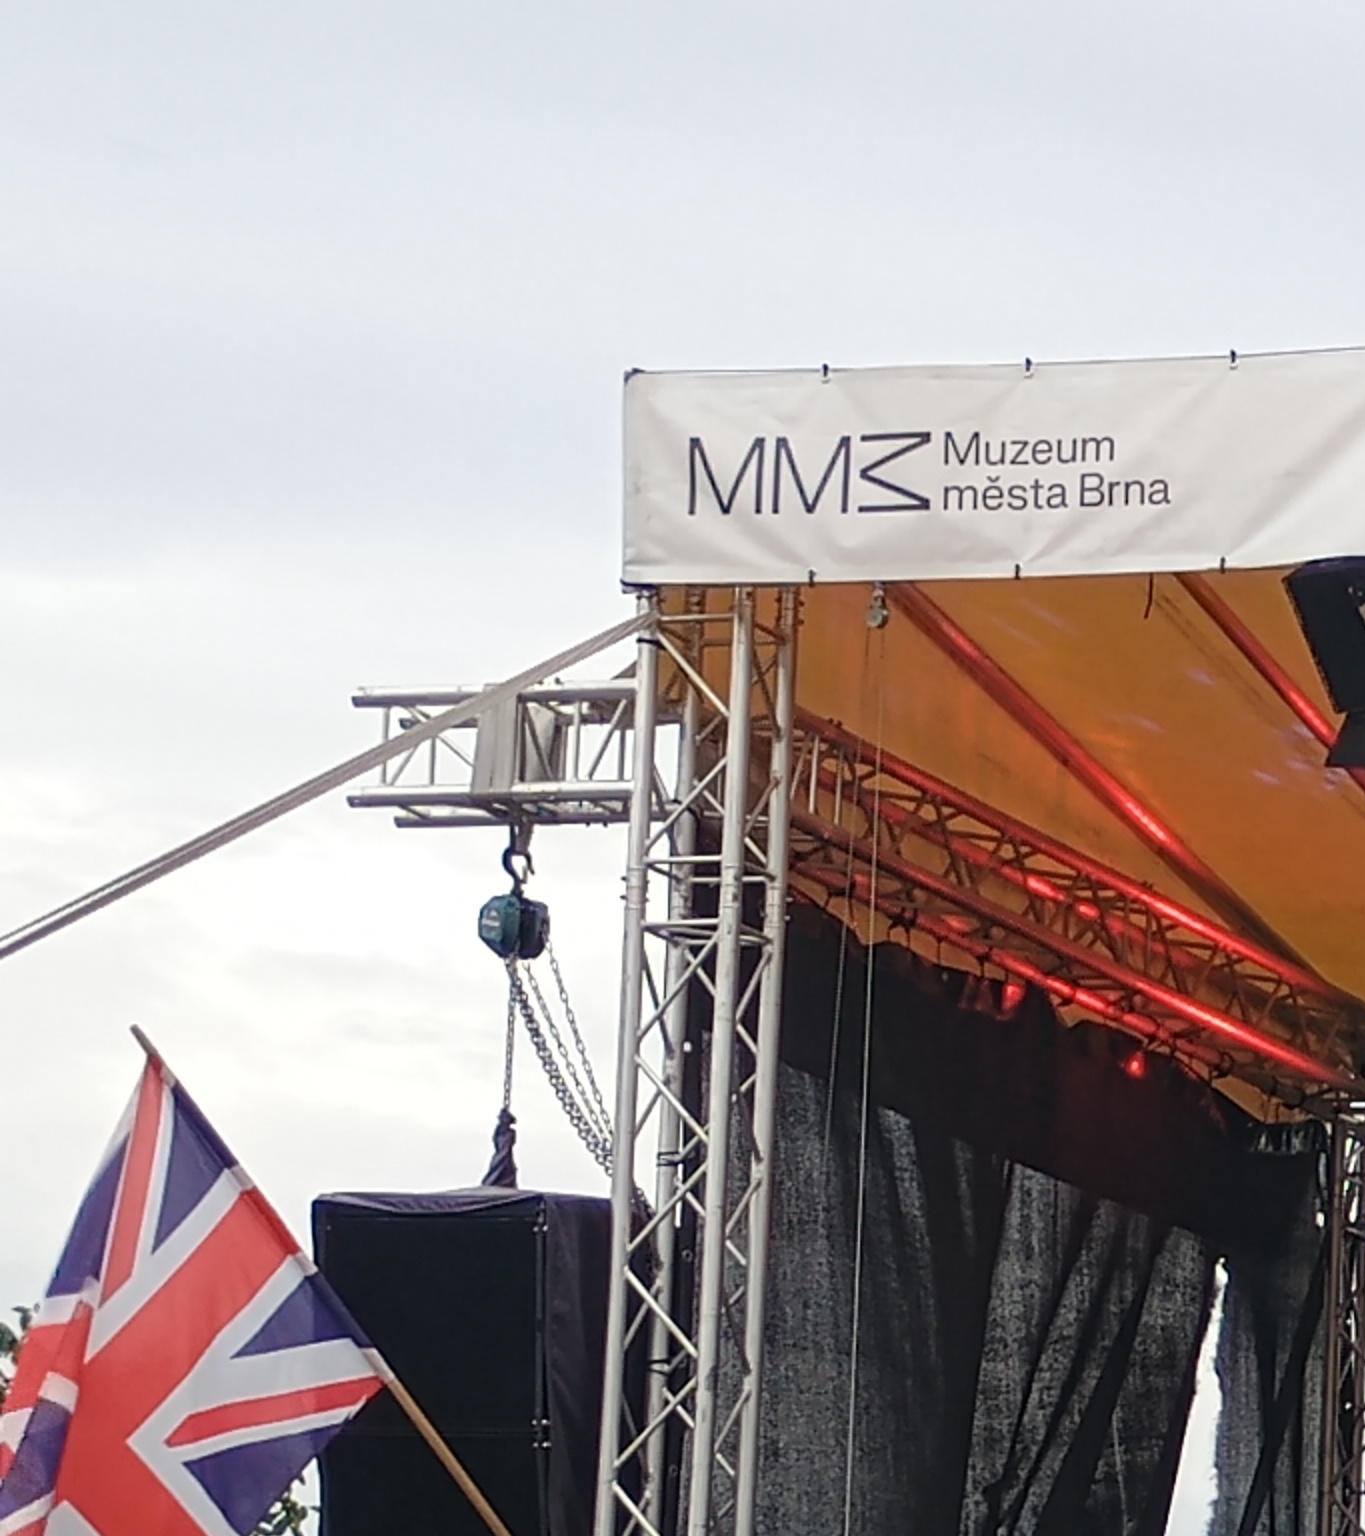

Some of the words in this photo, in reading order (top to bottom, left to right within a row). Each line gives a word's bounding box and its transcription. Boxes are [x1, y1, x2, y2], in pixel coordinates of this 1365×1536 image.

[943, 430, 1115, 467] Muzeum
[943, 475, 1069, 511] města
[1079, 472, 1172, 508] Brna
